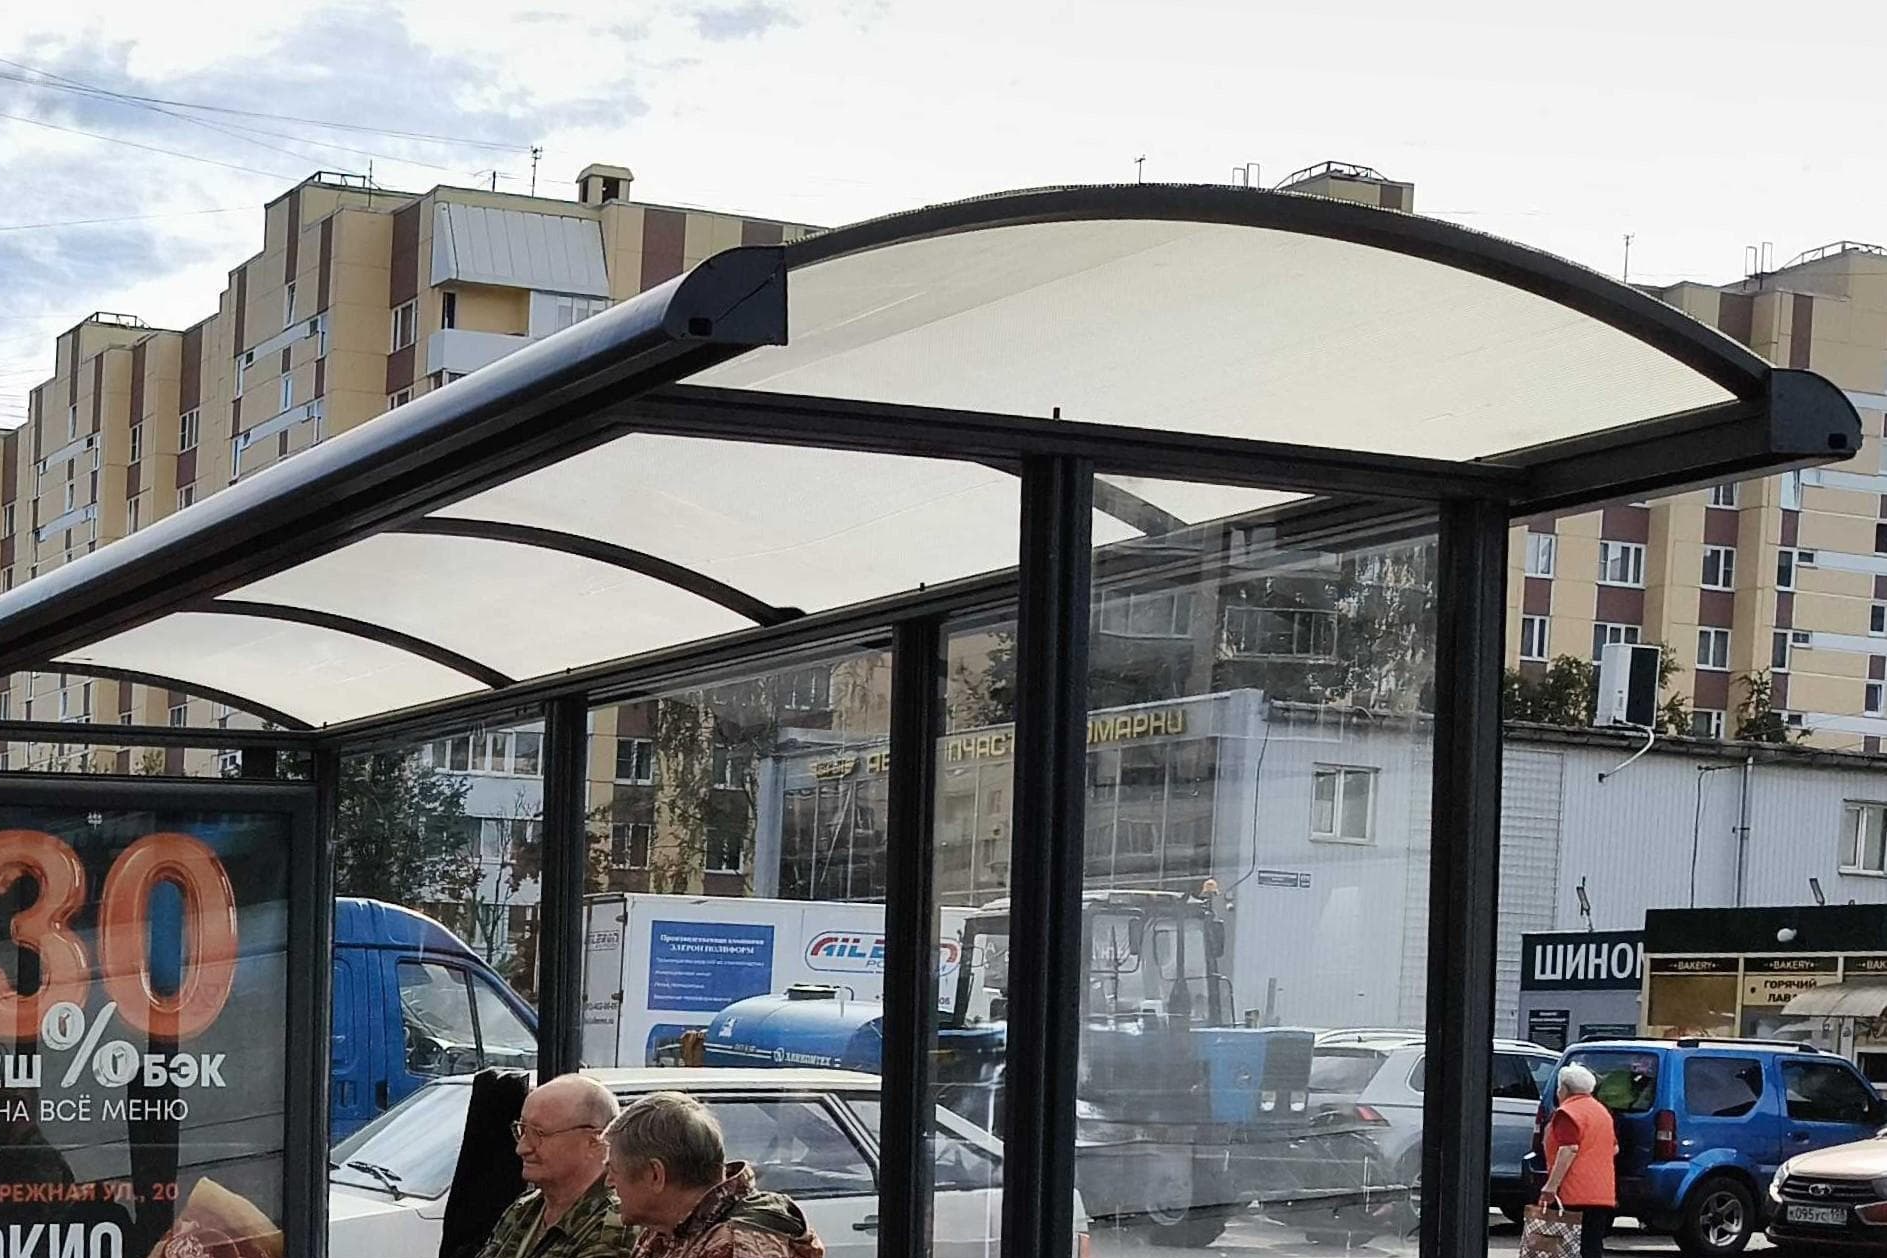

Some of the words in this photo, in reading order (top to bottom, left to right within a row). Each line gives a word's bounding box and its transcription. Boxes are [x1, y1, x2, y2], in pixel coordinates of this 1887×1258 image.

[1677, 961, 1713, 971] BAKERY
[1773, 960, 1811, 970] BAKERY
[1764, 978, 1817, 989] ГОРЯЧИЙ
[143, 1053, 226, 1088] БЭК
[40, 1094, 91, 1121] ВСЁ
[102, 1099, 189, 1121] МЕНЮ
[153, 1183, 180, 1200] 20
